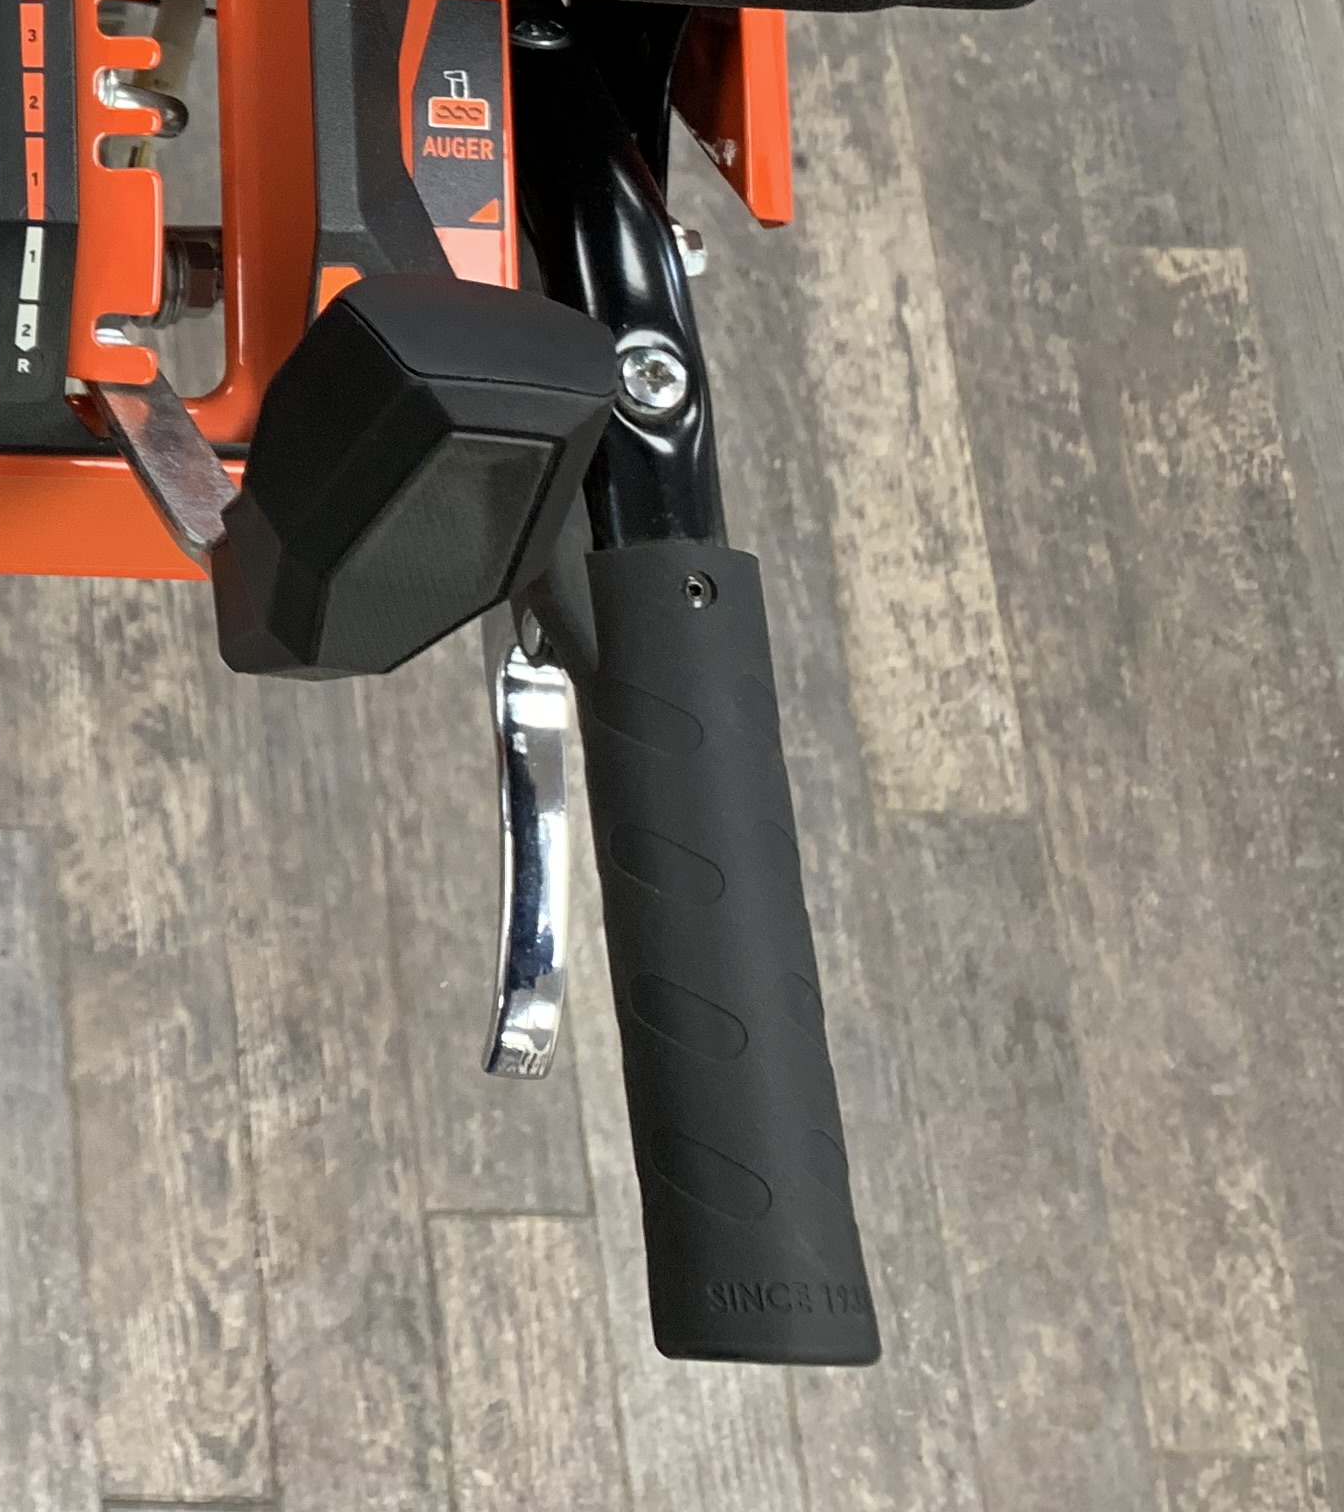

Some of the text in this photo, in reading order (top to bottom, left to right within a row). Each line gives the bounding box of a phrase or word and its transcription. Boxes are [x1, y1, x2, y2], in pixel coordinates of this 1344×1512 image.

[27, 29, 38, 43] 3
[29, 95, 39, 110] 2
[422, 136, 495, 161] AUGER
[31, 172, 39, 187] 1
[28, 249, 37, 264] 1
[21, 323, 32, 337] 2
[16, 358, 31, 374] R
